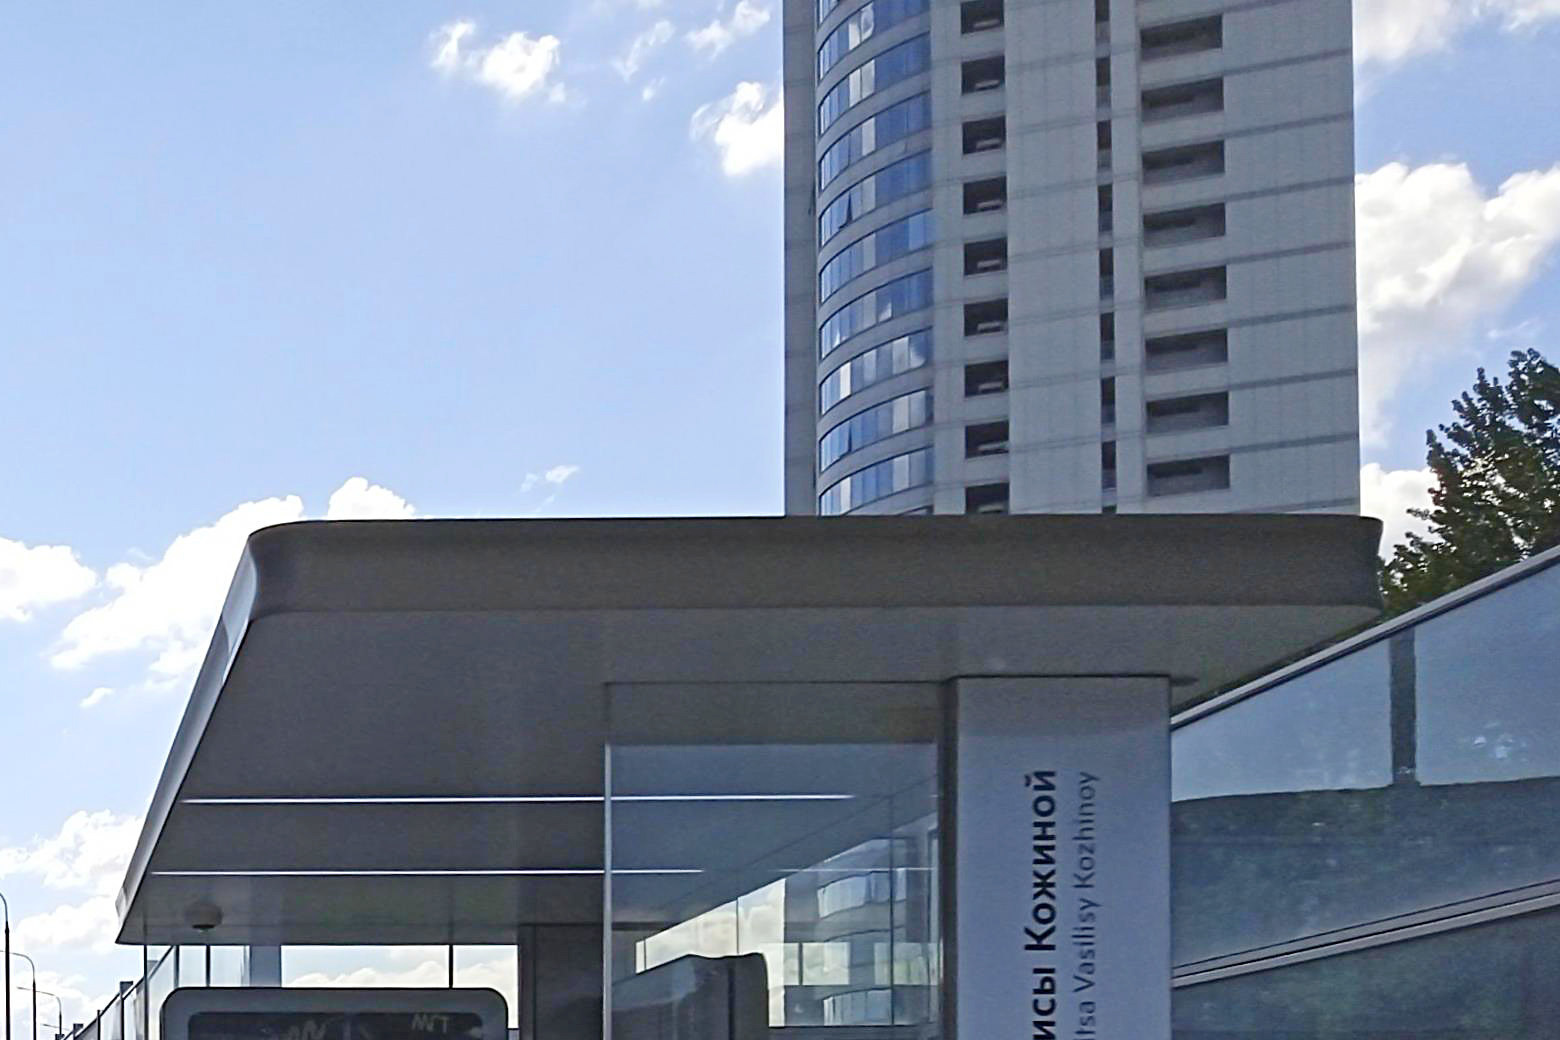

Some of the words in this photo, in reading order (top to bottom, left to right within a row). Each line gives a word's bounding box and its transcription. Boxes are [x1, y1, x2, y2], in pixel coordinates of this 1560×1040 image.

[1023, 770, 1057, 952] Кожиной
[1071, 771, 1101, 889] Kozhinoy
[1071, 898, 1103, 993] Vasilisy
